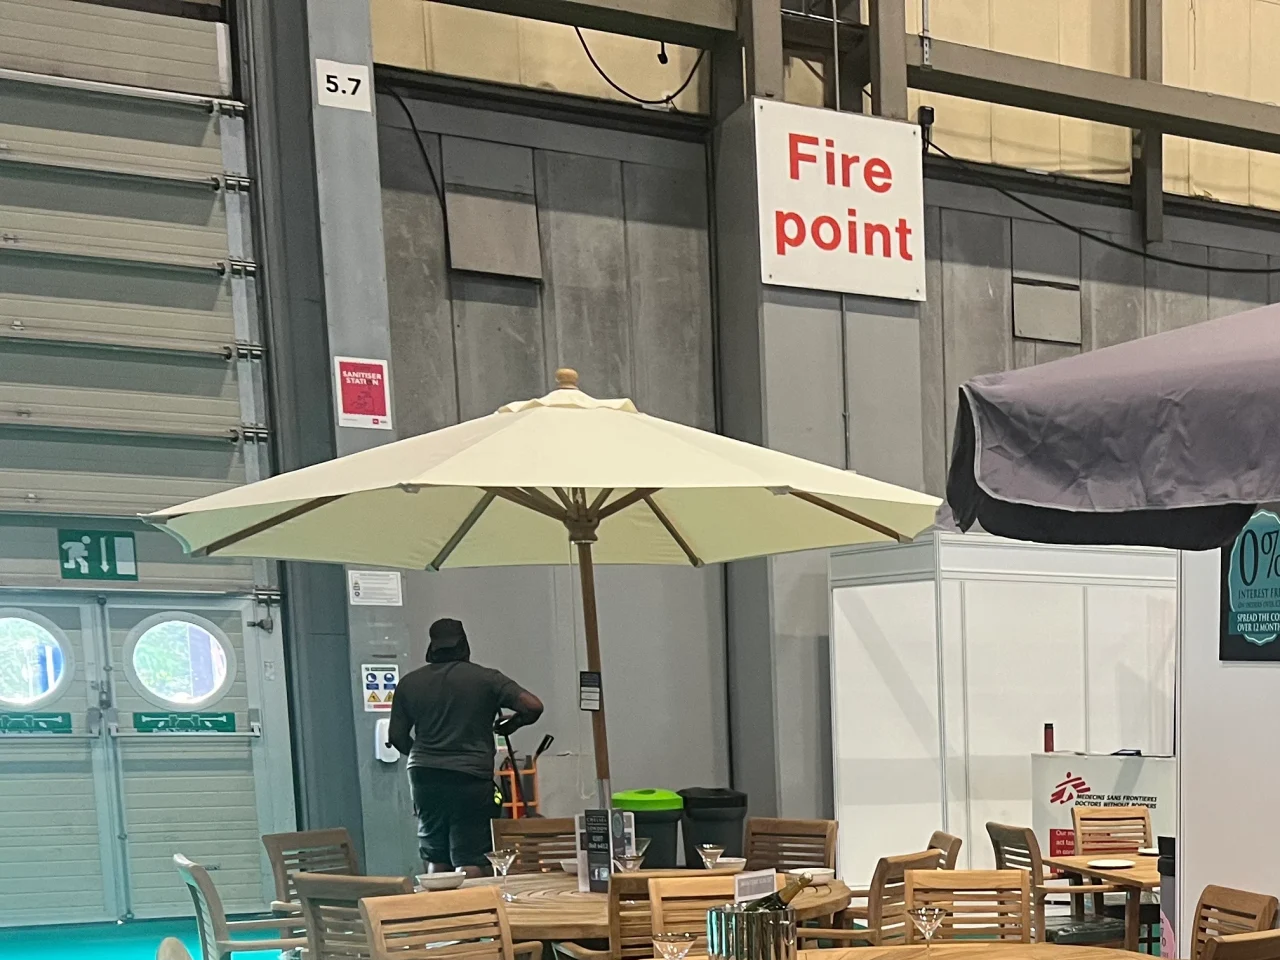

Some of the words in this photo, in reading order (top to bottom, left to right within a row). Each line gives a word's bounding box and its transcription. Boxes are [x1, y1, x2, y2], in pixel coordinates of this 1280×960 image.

[326, 74, 361, 95] 5.7
[789, 133, 892, 193] Fire
[775, 208, 913, 261] point
[342, 370, 382, 380] SANITISER
[1238, 588, 1268, 599] INTEREST
[1237, 613, 1258, 622] SPREAD
[1258, 613, 1270, 622] THE
[1237, 623, 1252, 632] OVER
[1253, 622, 1259, 632] 12
